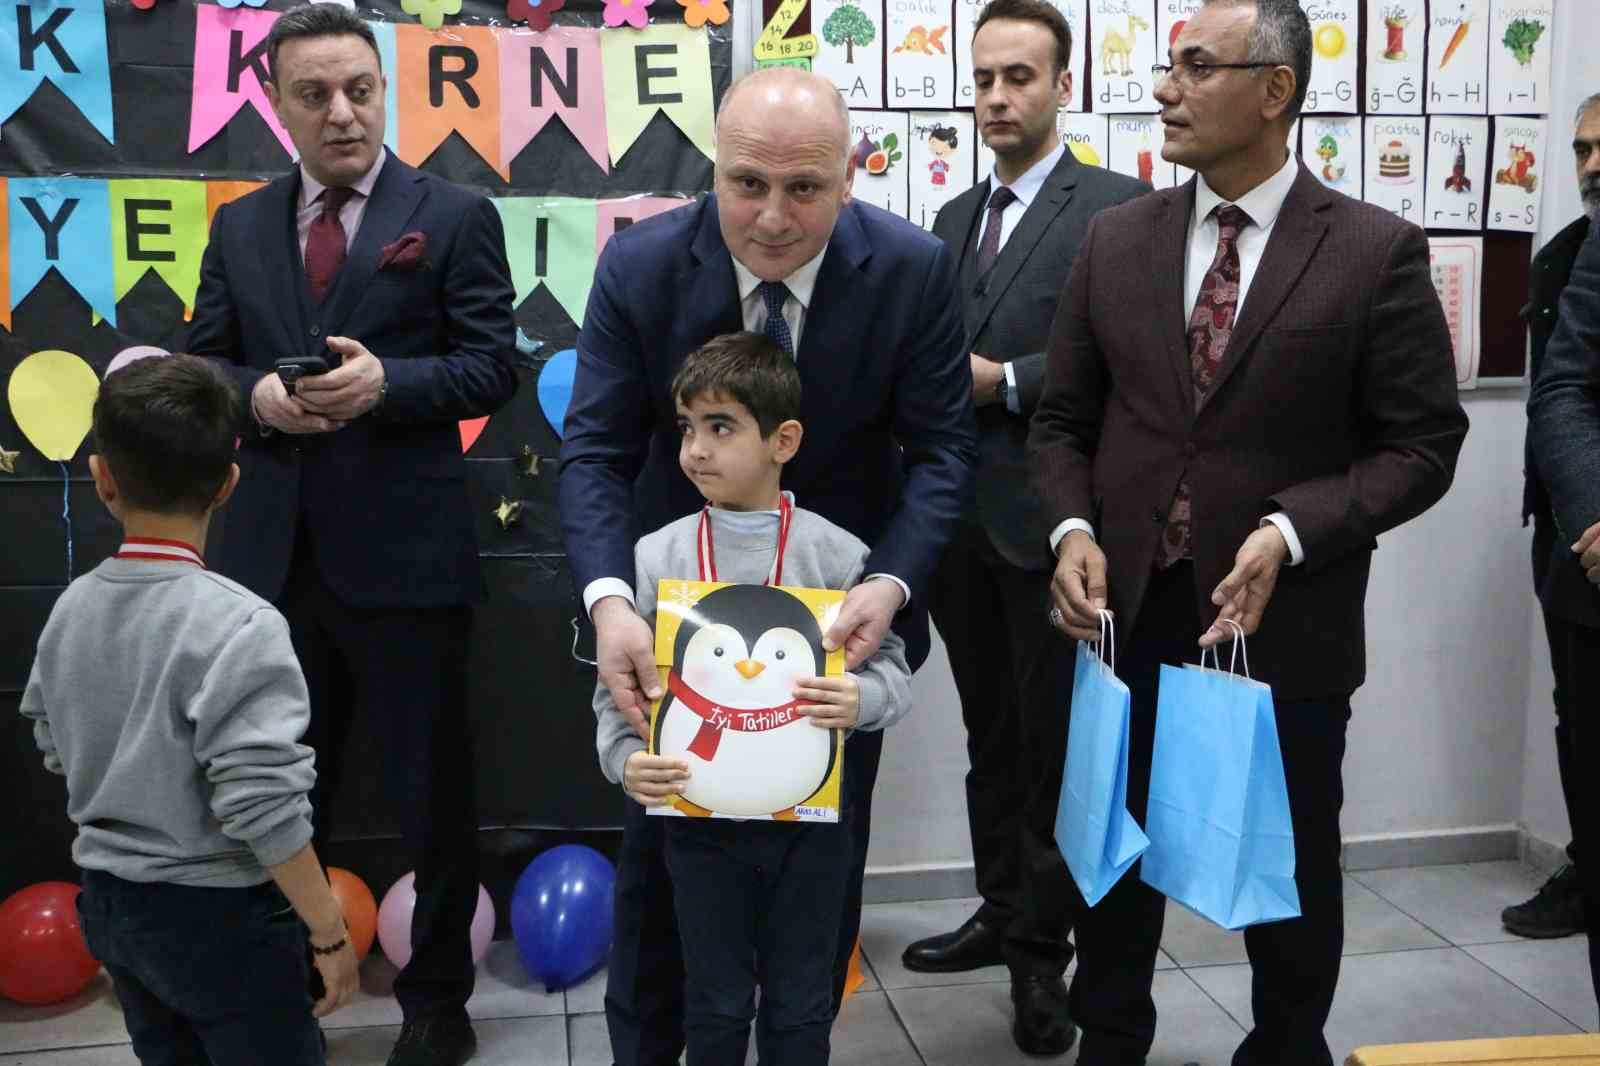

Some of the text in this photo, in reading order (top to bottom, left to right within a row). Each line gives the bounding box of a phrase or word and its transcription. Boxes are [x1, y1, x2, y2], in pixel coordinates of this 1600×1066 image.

[779, 10, 793, 20] 12
[15, 5, 81, 74] K
[770, 24, 783, 36] 14
[761, 41, 814, 55] 16 18 20
[1374, 121, 1421, 144] pasta
[1433, 128, 1472, 147] roket
[737, 707, 794, 731] Tatiller
